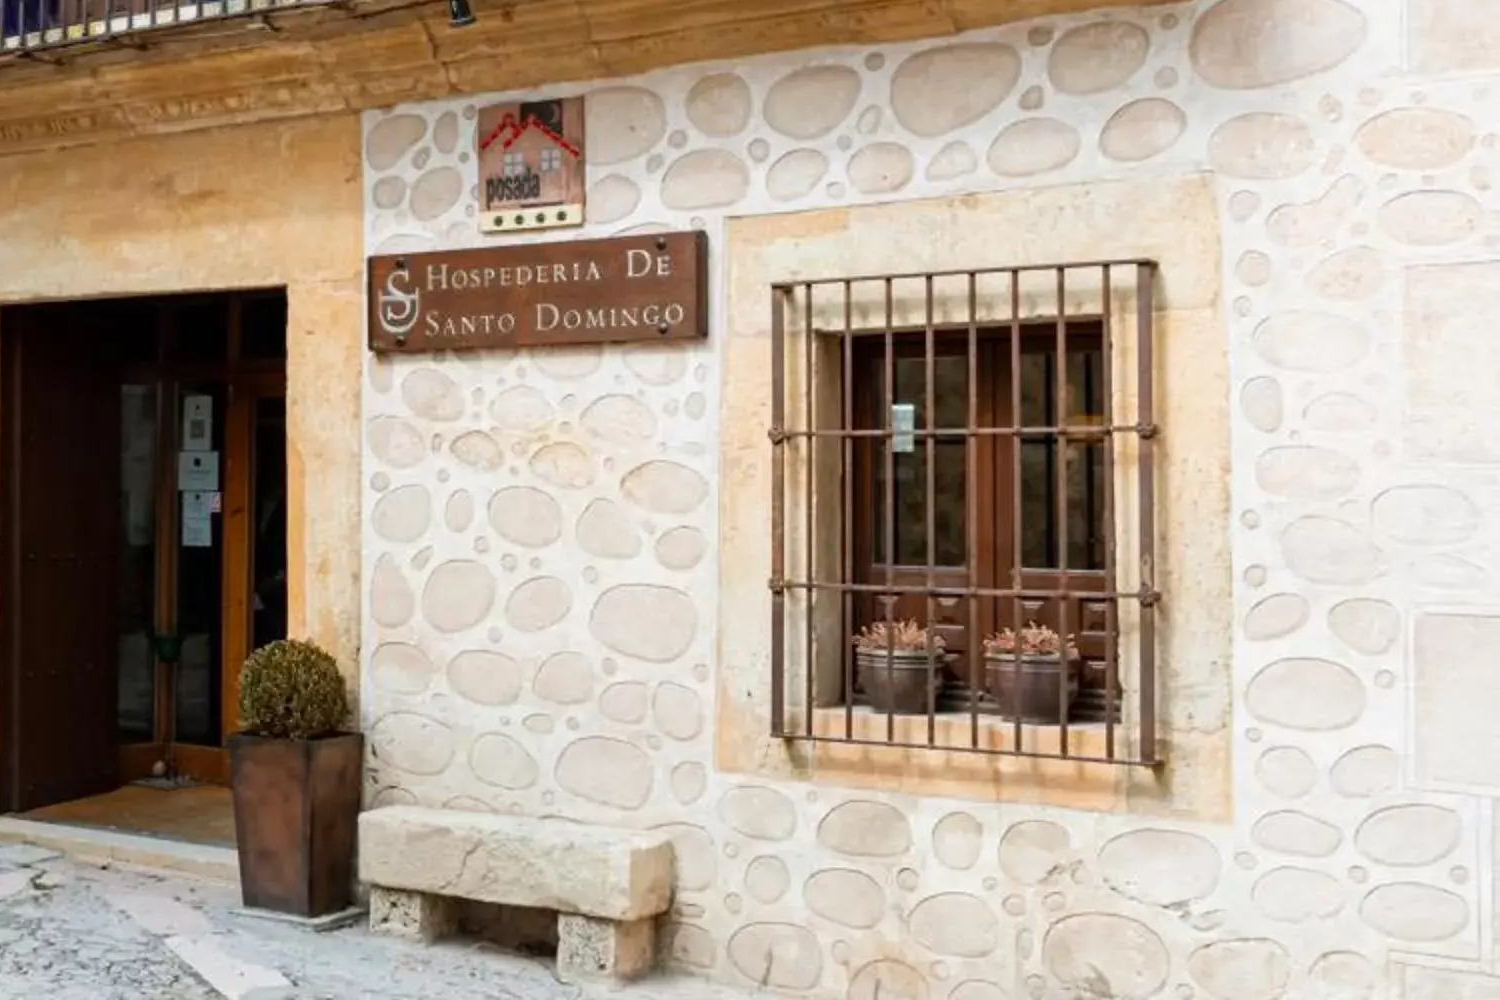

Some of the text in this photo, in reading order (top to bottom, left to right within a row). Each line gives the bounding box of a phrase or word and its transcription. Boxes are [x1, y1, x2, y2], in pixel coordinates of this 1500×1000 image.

[486, 168, 540, 211] posada
[426, 249, 671, 291] HOSPEDERIA DE
[425, 303, 684, 337] SANTO DOMINGO
